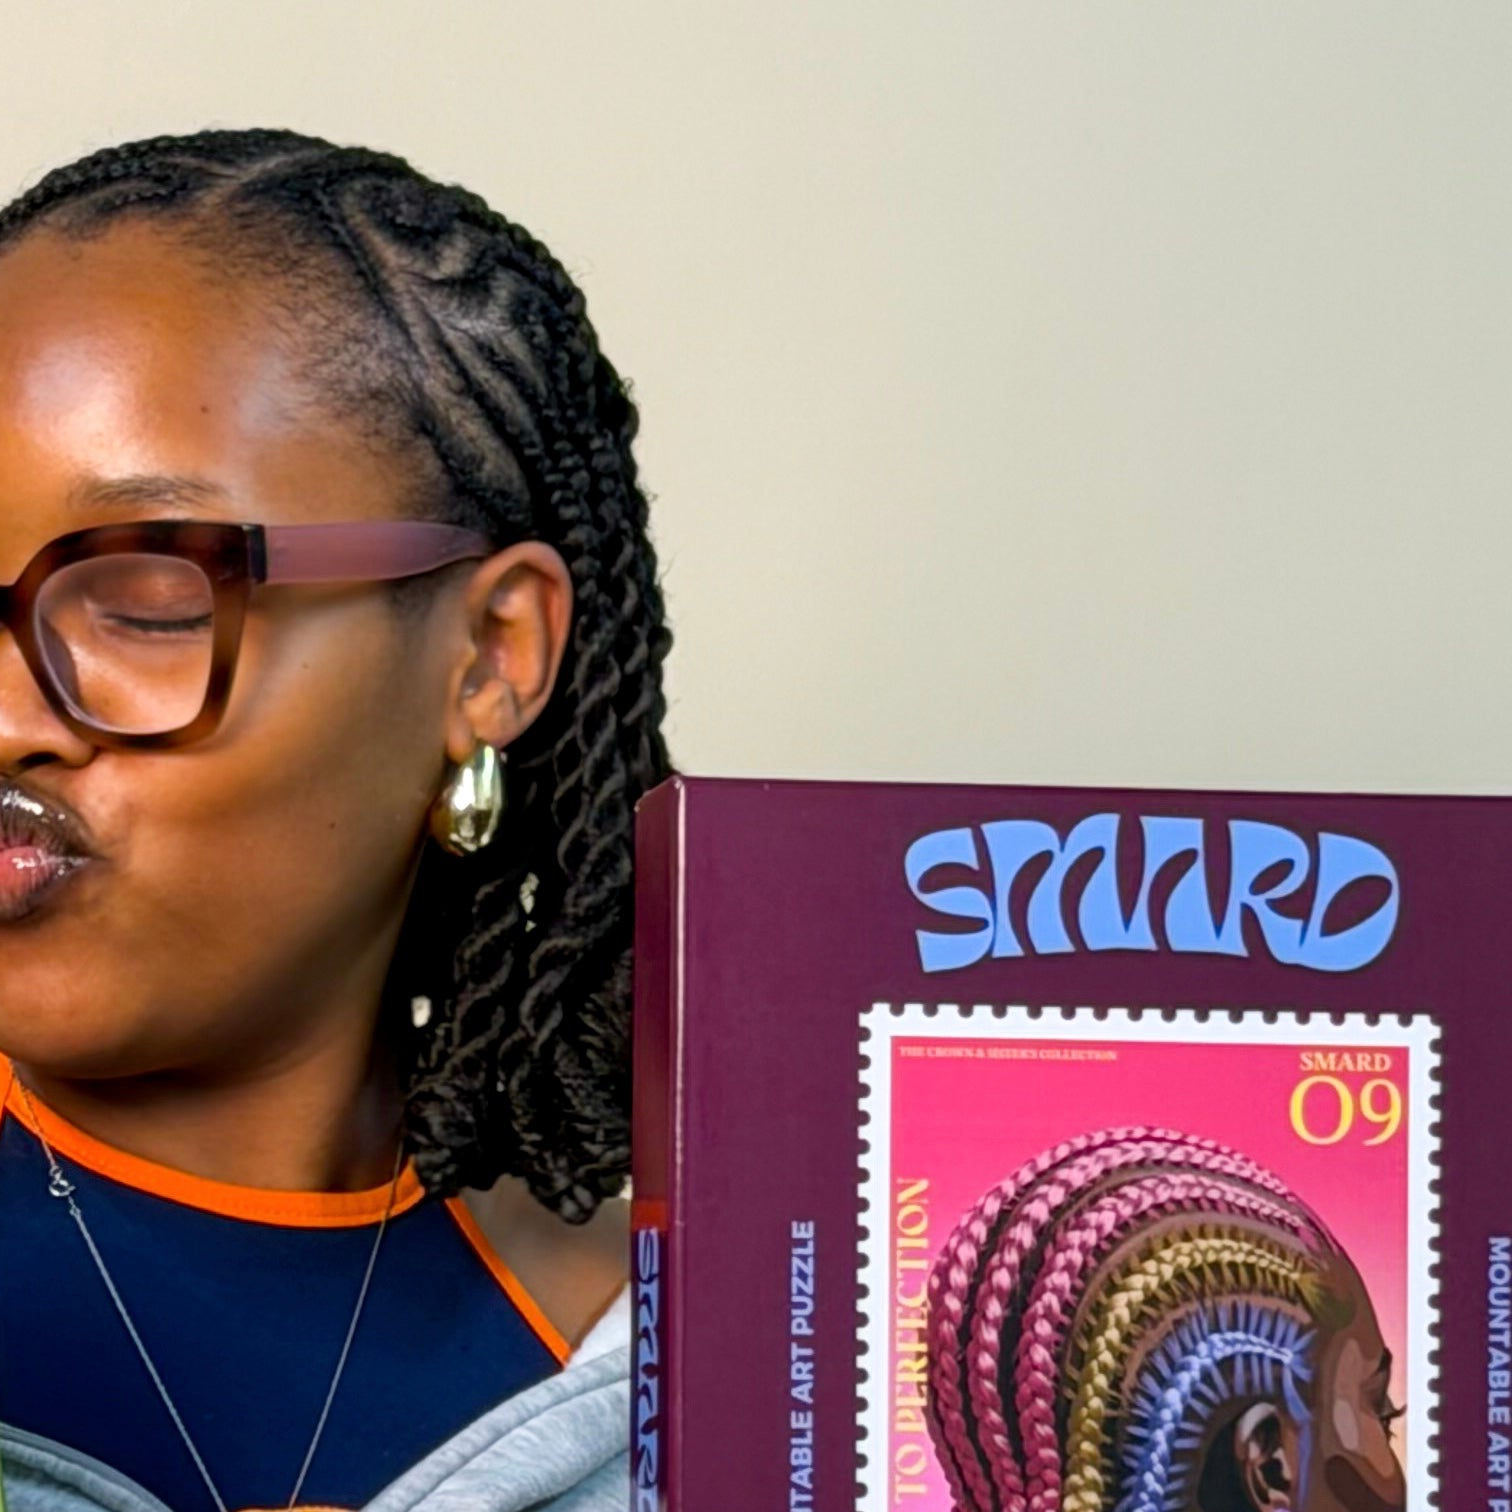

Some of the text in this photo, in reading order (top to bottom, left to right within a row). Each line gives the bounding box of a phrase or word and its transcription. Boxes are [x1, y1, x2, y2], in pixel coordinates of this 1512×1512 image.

[904, 812, 1399, 973] SMARD
[1299, 1052, 1392, 1072] SMARD
[791, 1220, 815, 1336] PUZZLE
[895, 1177, 929, 1433] PERFECTION
[790, 1342, 815, 1405] ART
[1487, 1236, 1511, 1426] MOUNTABLE
[894, 1443, 928, 1505] TO
[1487, 1431, 1511, 1493] ART
